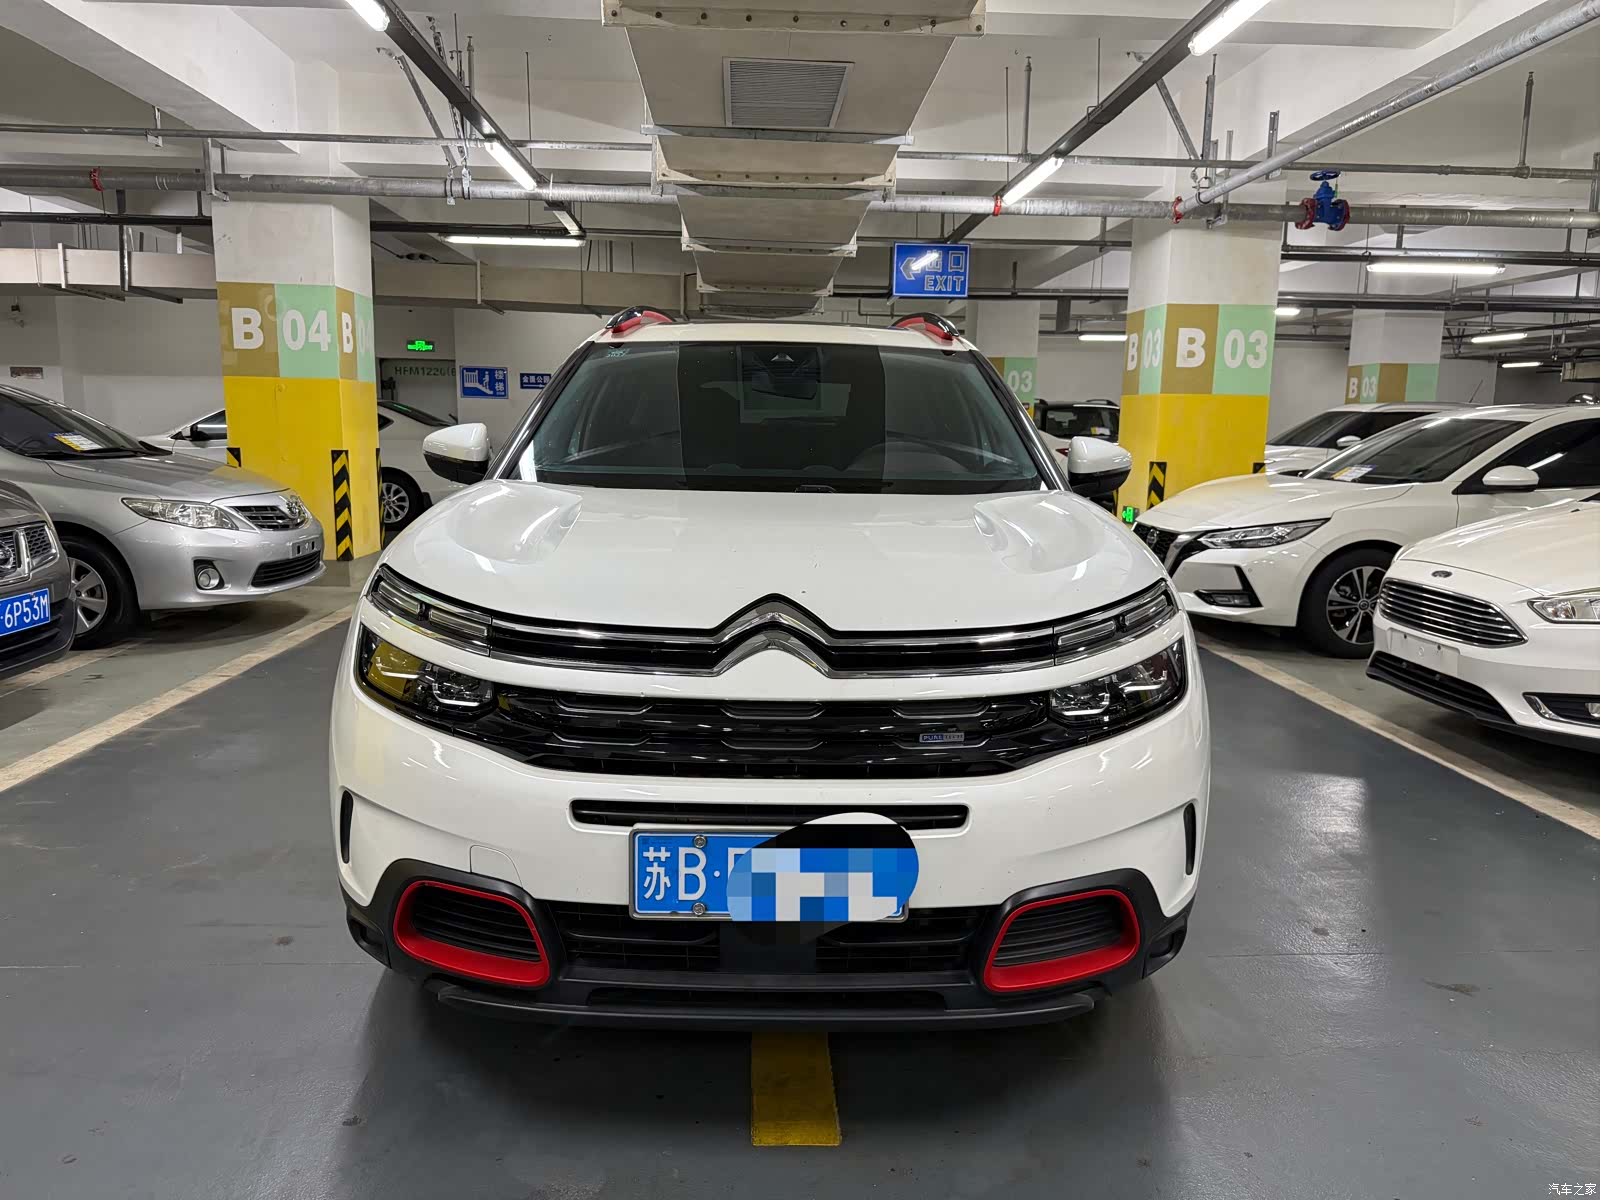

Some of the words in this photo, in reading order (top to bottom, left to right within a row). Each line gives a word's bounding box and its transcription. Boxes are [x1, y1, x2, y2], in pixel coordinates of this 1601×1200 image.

[925, 250, 965, 272] 出口
[924, 275, 964, 291] EXIT
[231, 307, 264, 350] B
[282, 309, 331, 352] 04
[341, 311, 354, 354] B
[1126, 333, 1139, 371] B
[1143, 328, 1162, 369] 03
[1175, 327, 1206, 368] B
[1223, 329, 1268, 369] 03
[494, 370, 505, 392] 楼梯
[1007, 370, 1033, 393] 03
[1349, 377, 1359, 399] B
[1362, 376, 1377, 398] 03
[0, 594, 49, 628] ·6P53M
[643, 846, 748, 901] 苏B·
